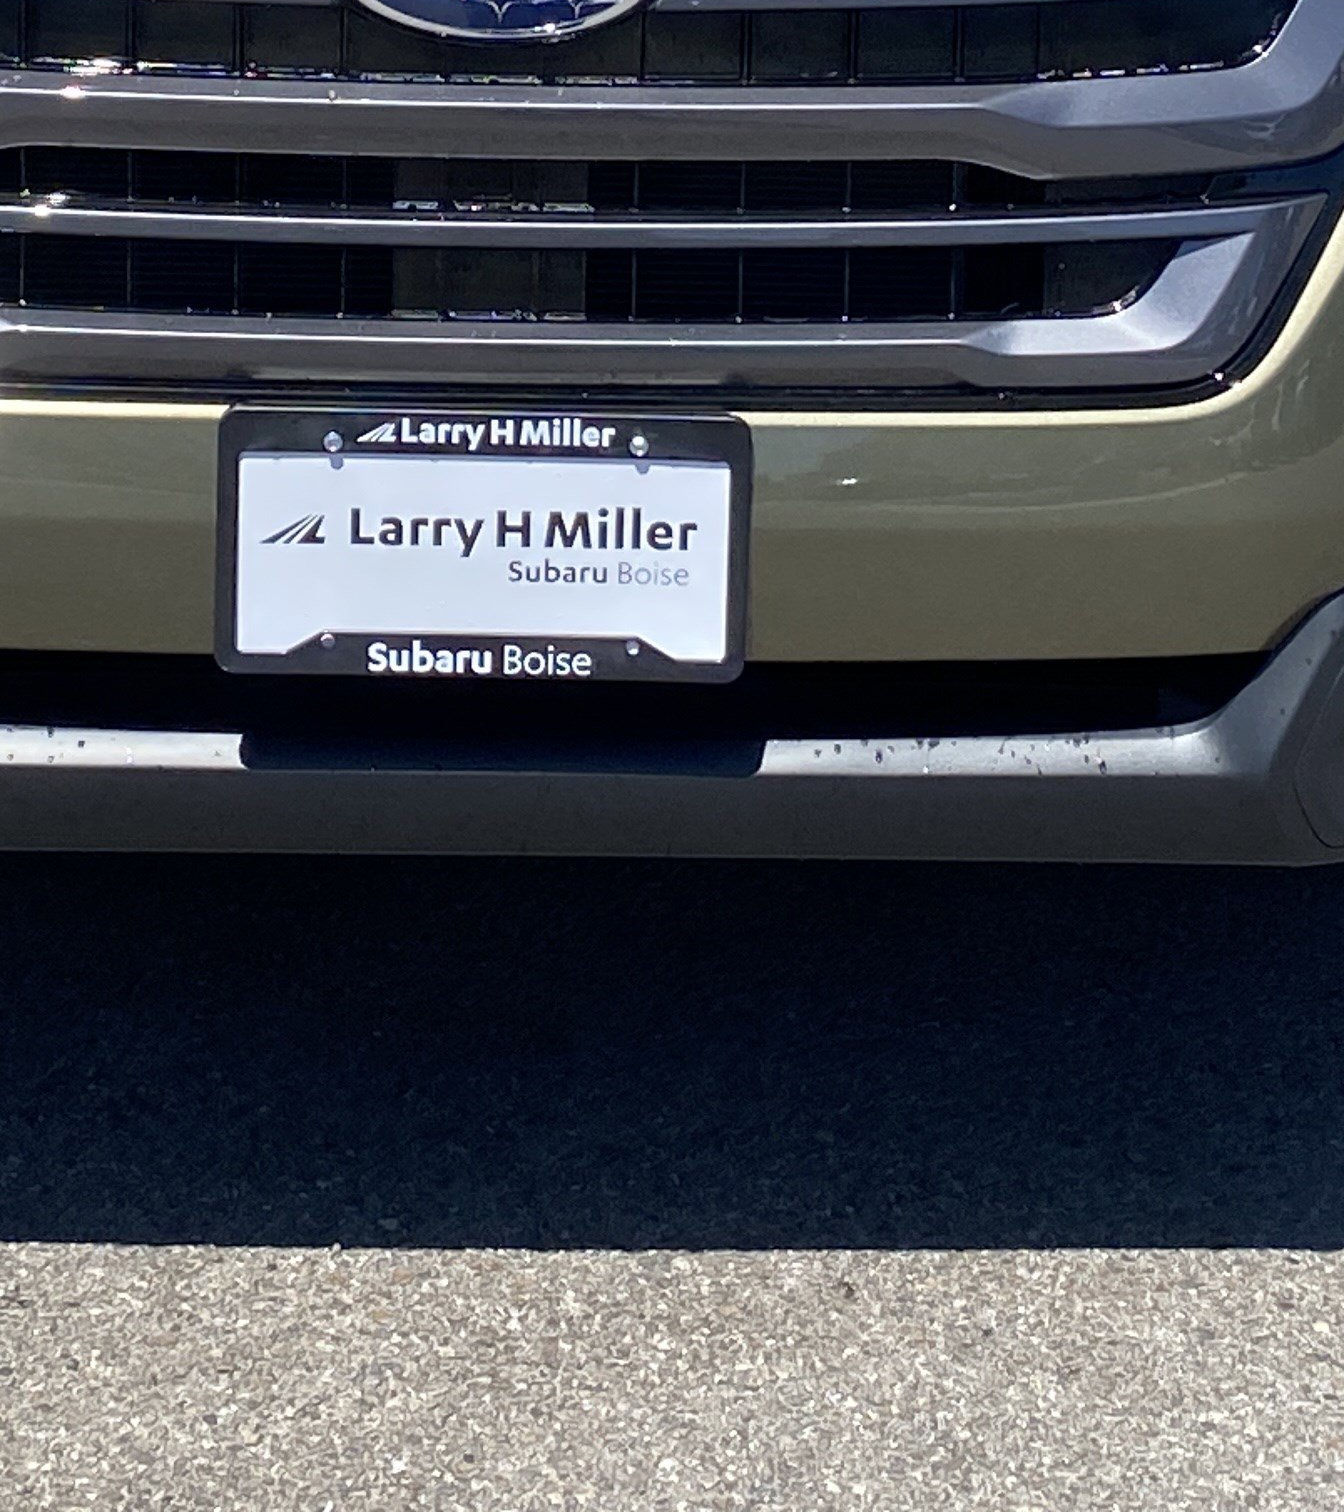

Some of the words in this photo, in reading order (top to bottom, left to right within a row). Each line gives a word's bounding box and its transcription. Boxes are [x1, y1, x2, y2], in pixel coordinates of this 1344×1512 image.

[402, 418, 484, 450] Larry
[491, 420, 515, 445] H
[520, 418, 615, 448] Miller
[351, 508, 485, 557] Larry
[497, 510, 532, 548] H
[545, 508, 698, 551] Miller
[509, 559, 608, 584] Subaru
[618, 562, 689, 586] Boise
[368, 640, 492, 673] Subaru
[503, 645, 592, 676] Boise
